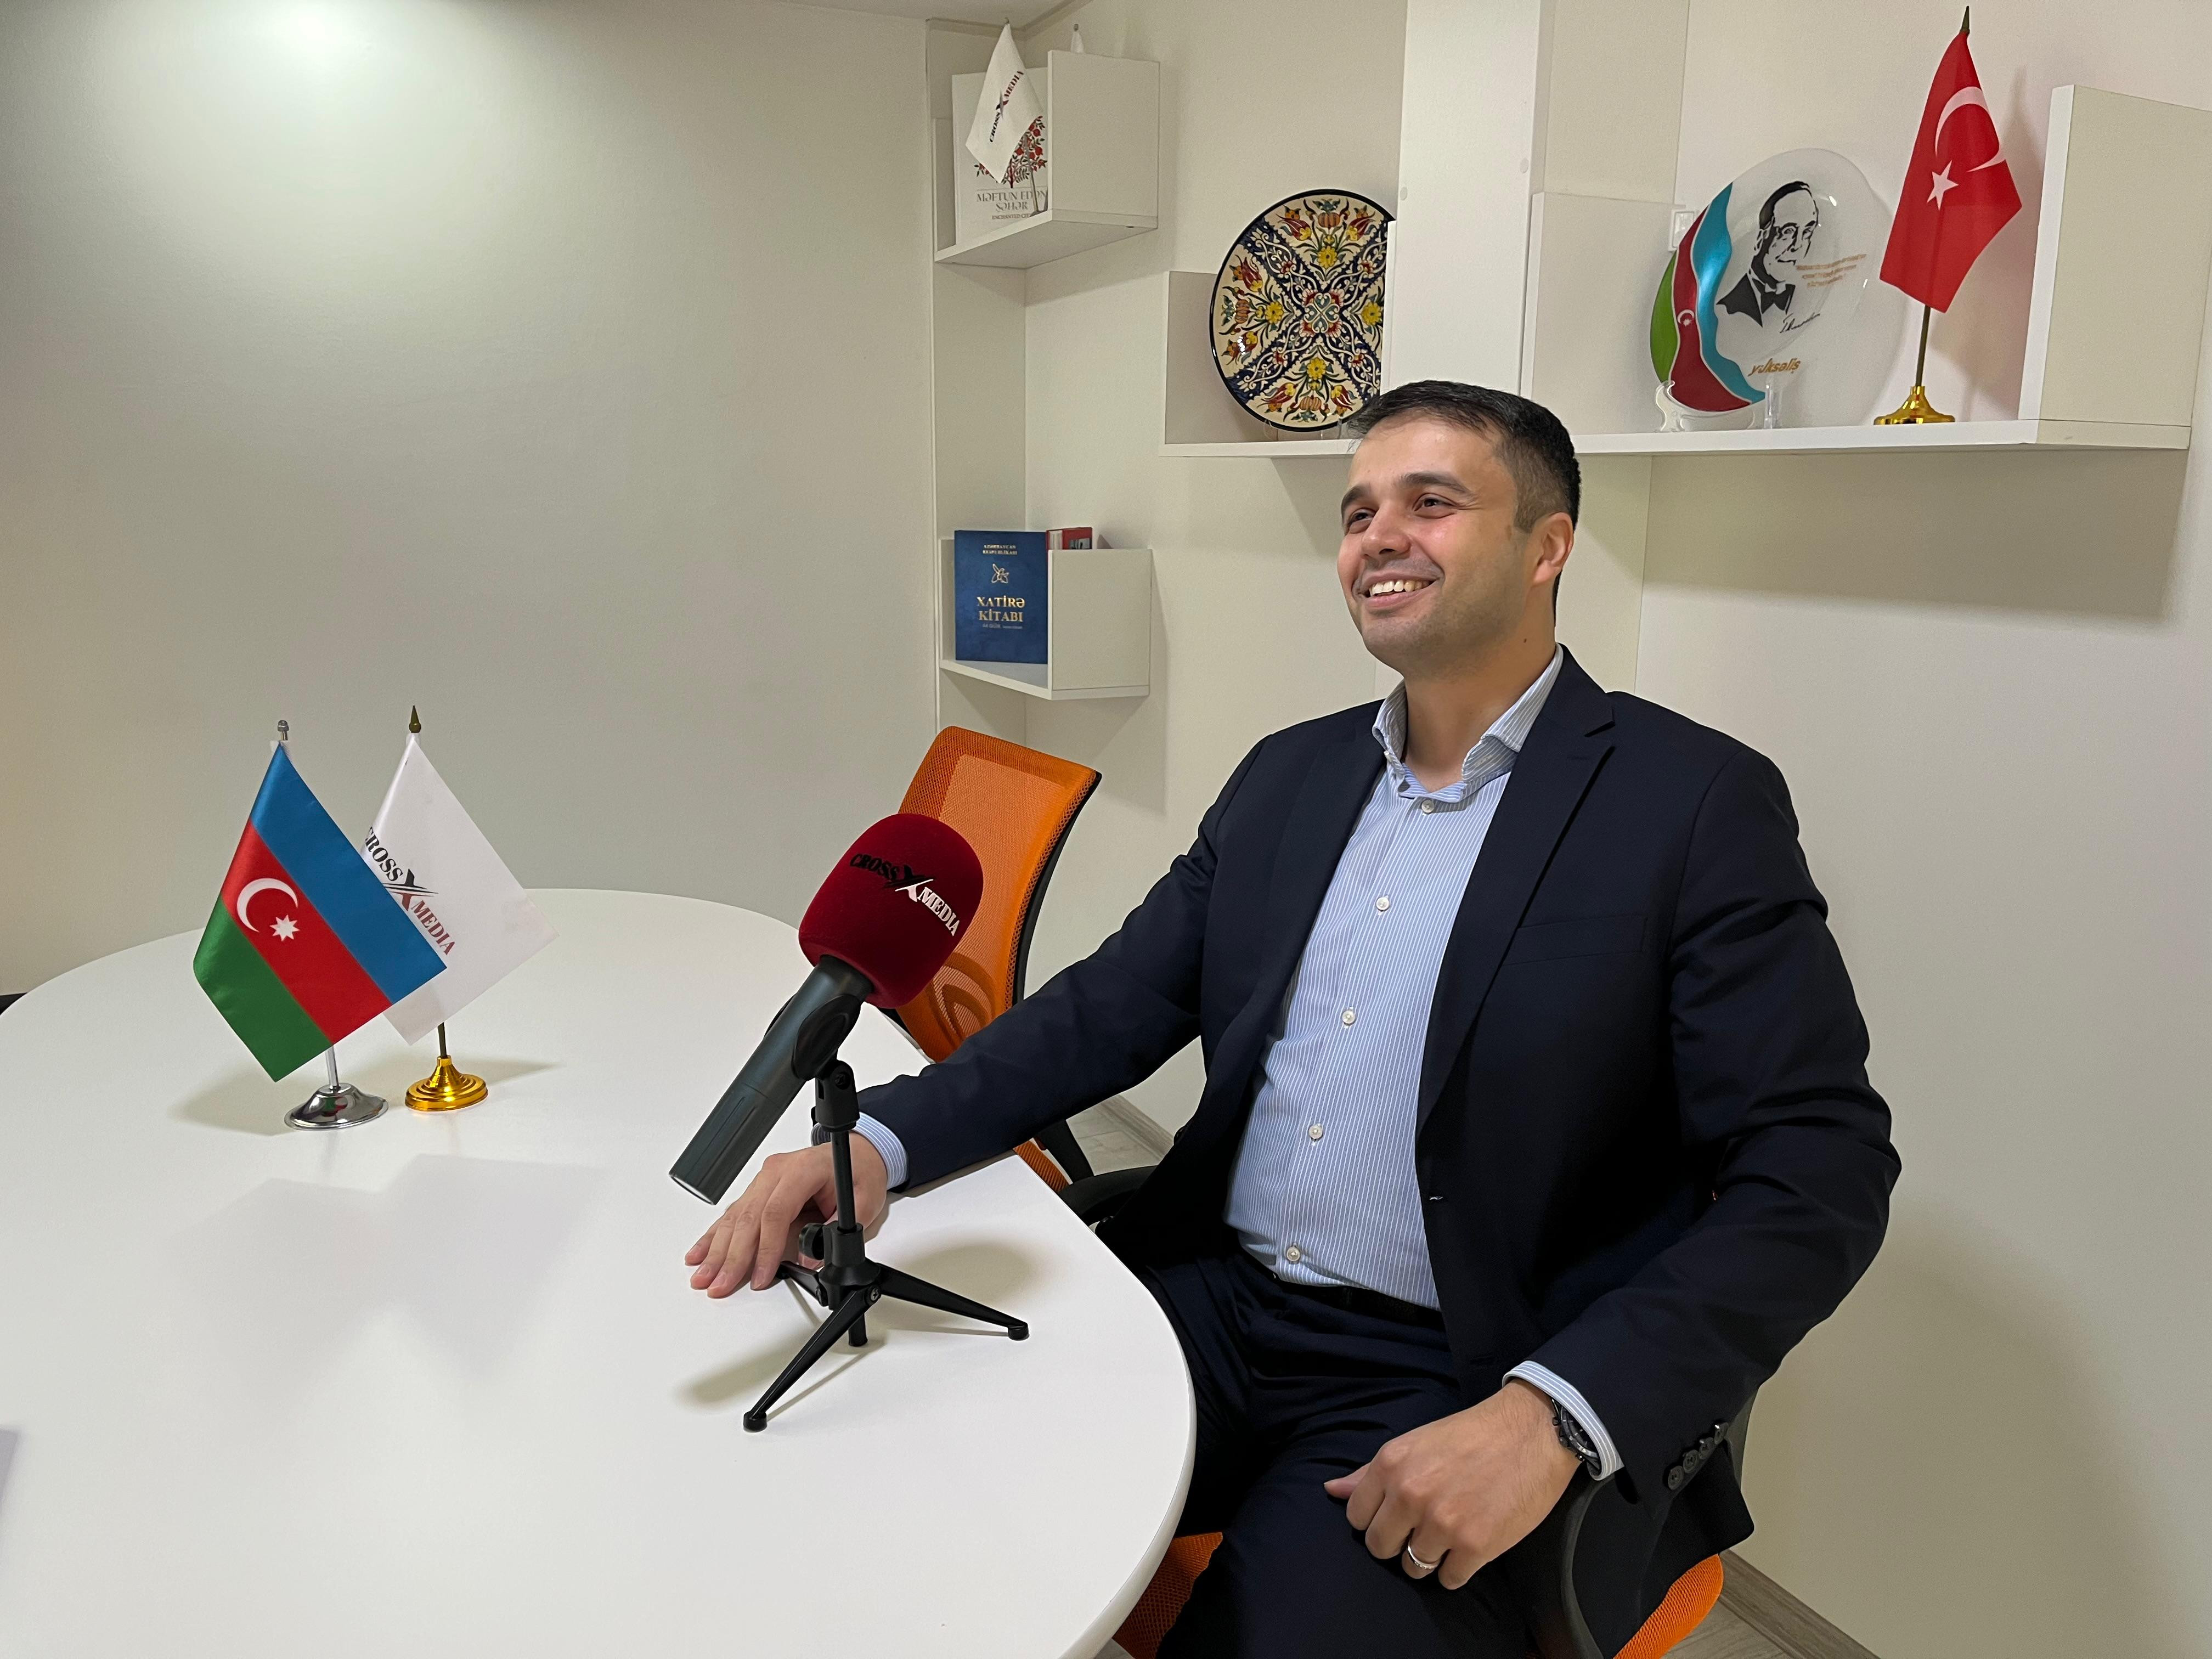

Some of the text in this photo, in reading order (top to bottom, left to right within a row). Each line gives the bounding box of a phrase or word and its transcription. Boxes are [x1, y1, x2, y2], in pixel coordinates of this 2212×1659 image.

[977, 595, 1025, 608] XATİRƏ
[978, 608, 1023, 622] KİTABI
[850, 854, 900, 881] CROSS
[917, 887, 960, 936] MEDIA
[411, 900, 455, 955] MEDIA
